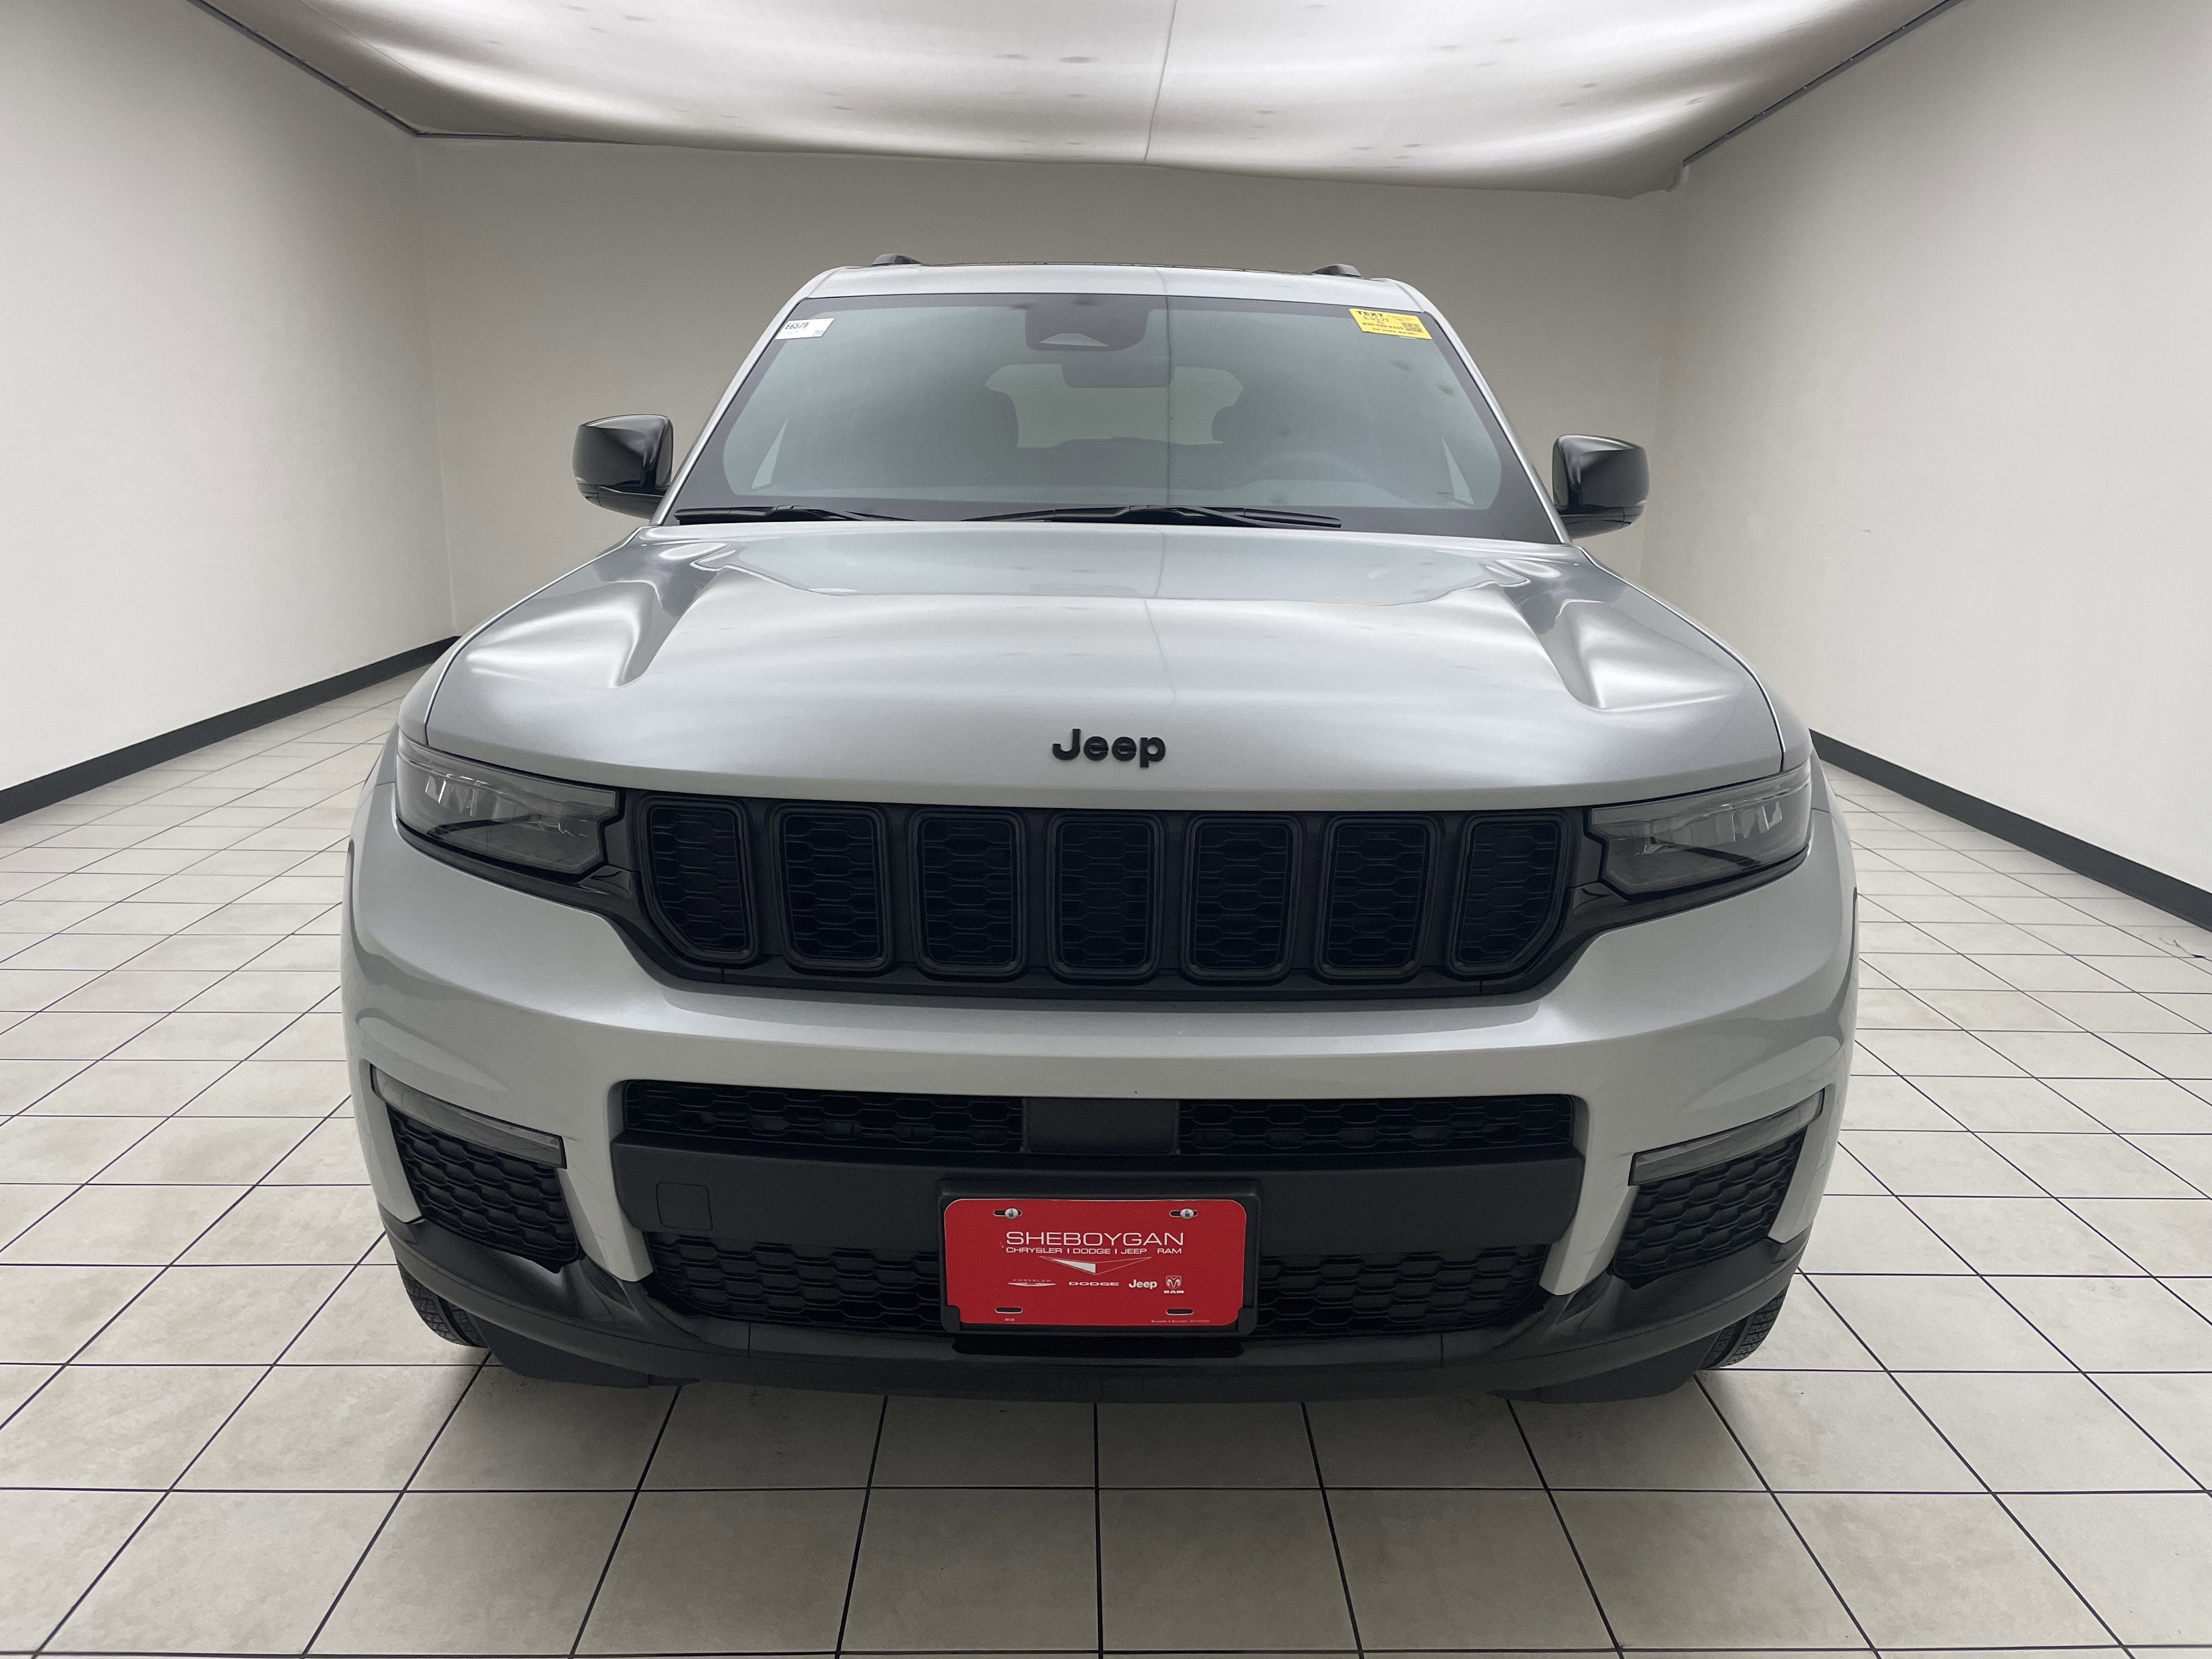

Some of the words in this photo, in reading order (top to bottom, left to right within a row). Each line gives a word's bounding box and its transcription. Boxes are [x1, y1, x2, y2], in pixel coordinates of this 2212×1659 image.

[1052, 729, 1166, 768] Jeep
[1006, 1231, 1184, 1246] SHEBOYGAN
[1128, 1279, 1158, 1290] Jeep
